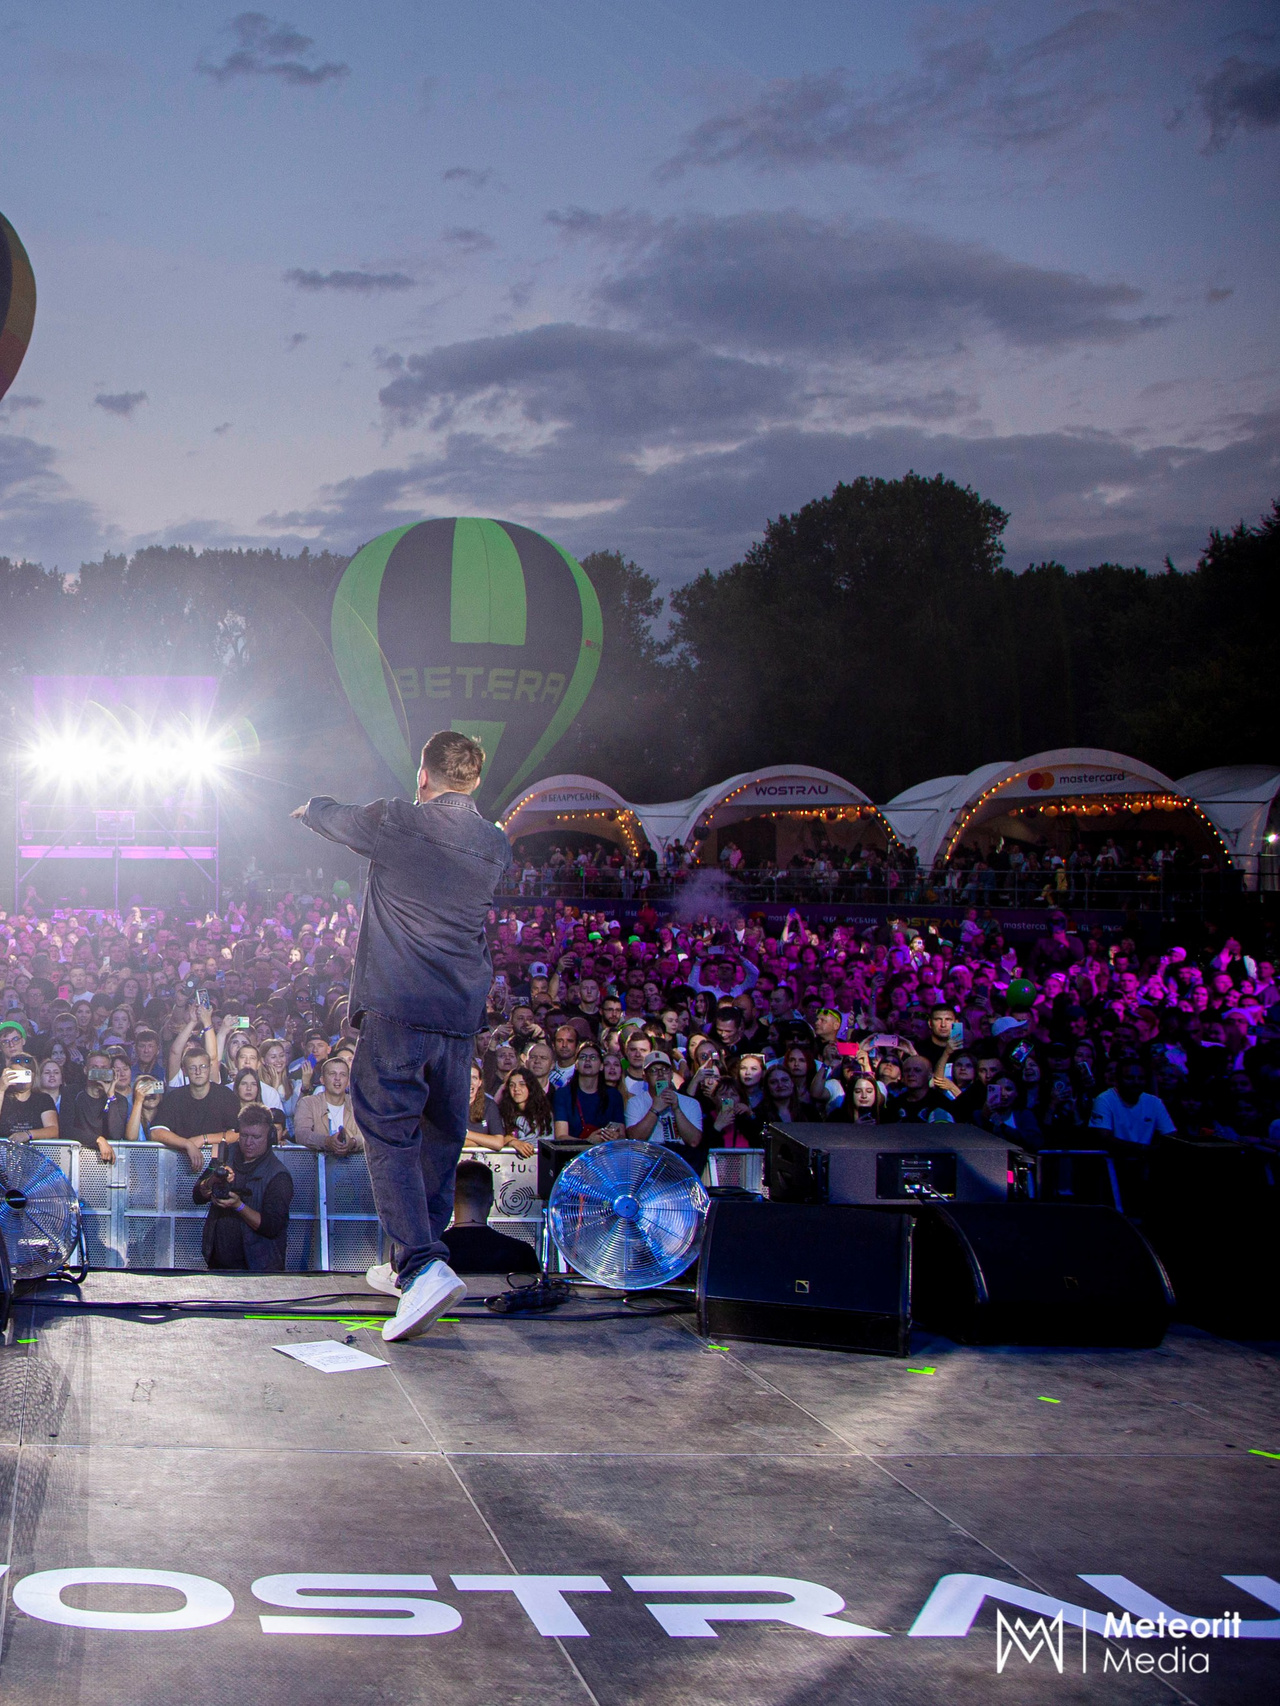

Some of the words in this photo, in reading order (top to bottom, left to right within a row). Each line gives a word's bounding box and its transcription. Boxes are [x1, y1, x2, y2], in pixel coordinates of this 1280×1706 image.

[1059, 771, 1125, 784] mastercard
[755, 785, 829, 796] WOSTRAU
[548, 792, 601, 802] БЕЛАРУСБАНК
